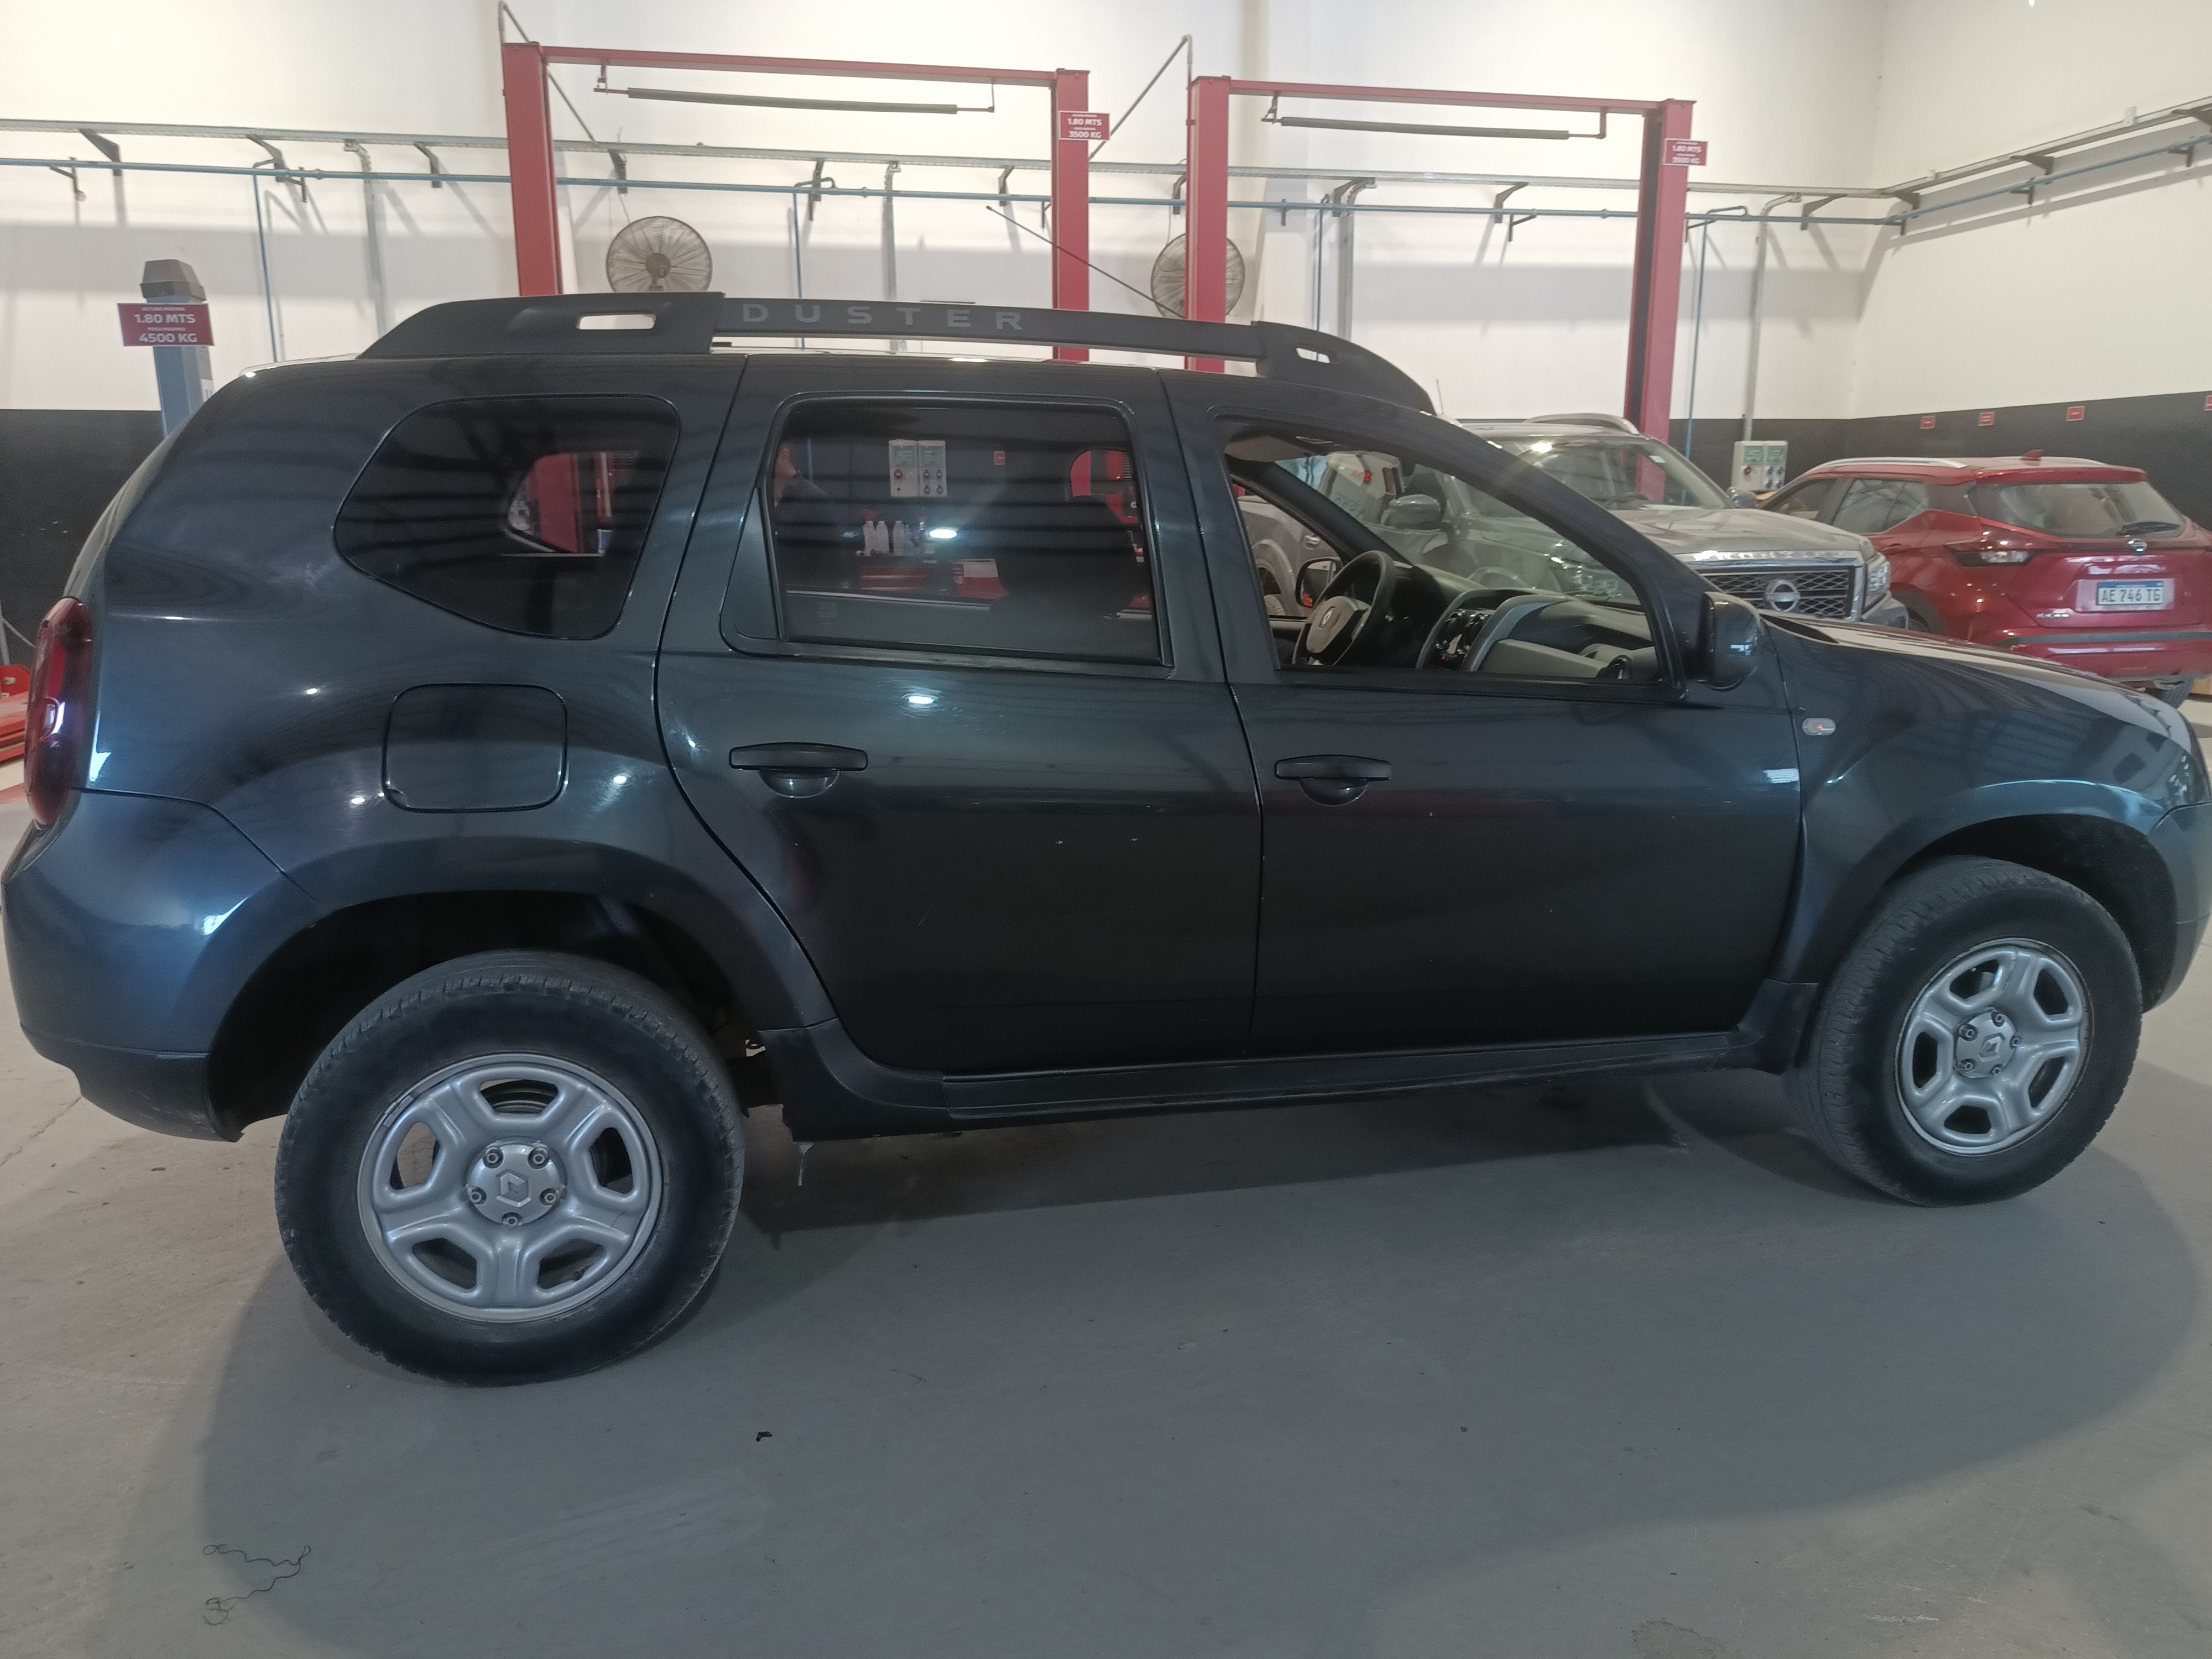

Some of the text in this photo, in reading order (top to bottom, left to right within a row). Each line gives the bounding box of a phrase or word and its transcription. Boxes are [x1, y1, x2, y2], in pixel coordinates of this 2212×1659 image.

[134, 314, 196, 324] 1.80 MTS
[742, 302, 1023, 331] DUSTER
[139, 333, 198, 343] 4500 KG
[2102, 588, 2161, 602] AE 746 TG
